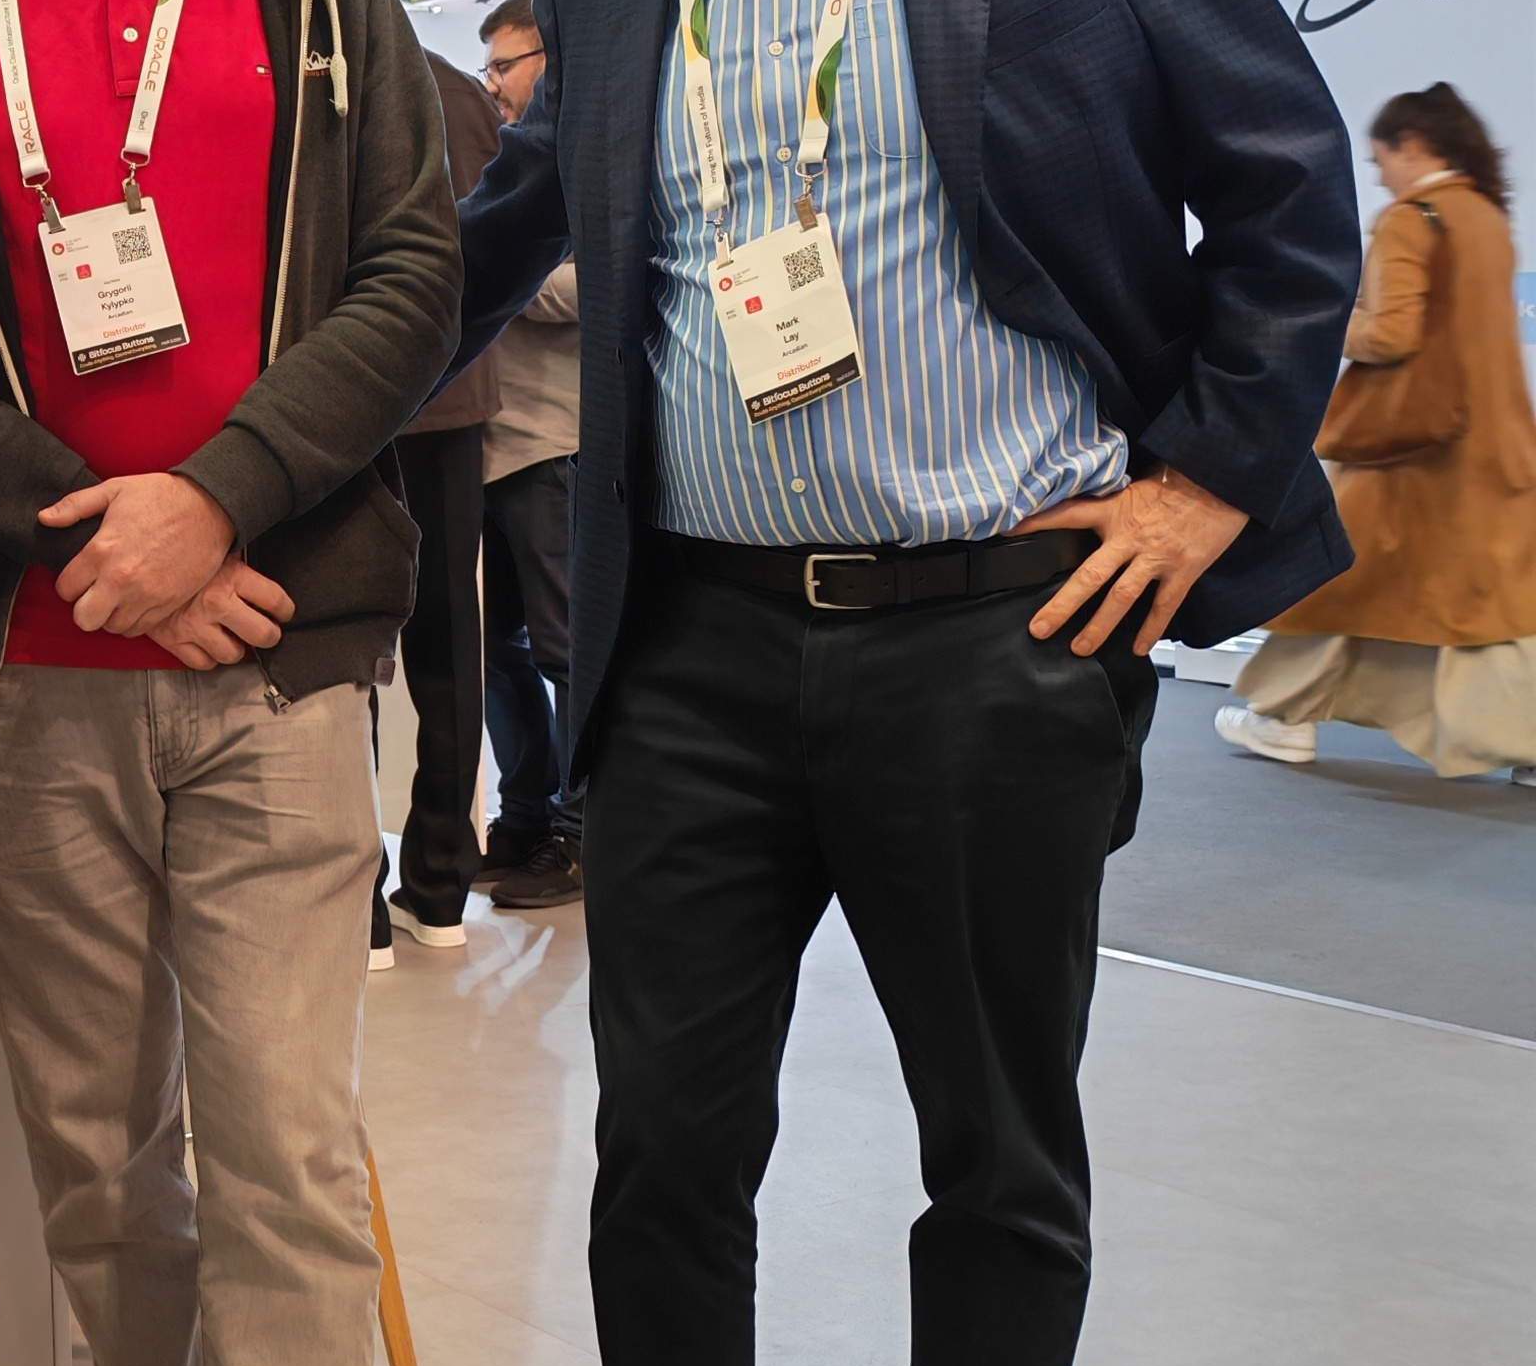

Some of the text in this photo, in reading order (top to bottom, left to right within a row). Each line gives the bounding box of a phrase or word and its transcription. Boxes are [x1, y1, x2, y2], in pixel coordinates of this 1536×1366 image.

[144, 26, 169, 92] ORACLE
[102, 321, 147, 339] Distributor
[775, 316, 800, 332] Mark
[88, 345, 122, 359] Bitfocus
[122, 336, 155, 350] Buttons
[783, 331, 800, 344] Lay
[782, 343, 808, 357] Arcadian
[777, 356, 822, 381] Distributor
[762, 387, 799, 406] Bitfocus
[798, 372, 831, 393] Buttons
